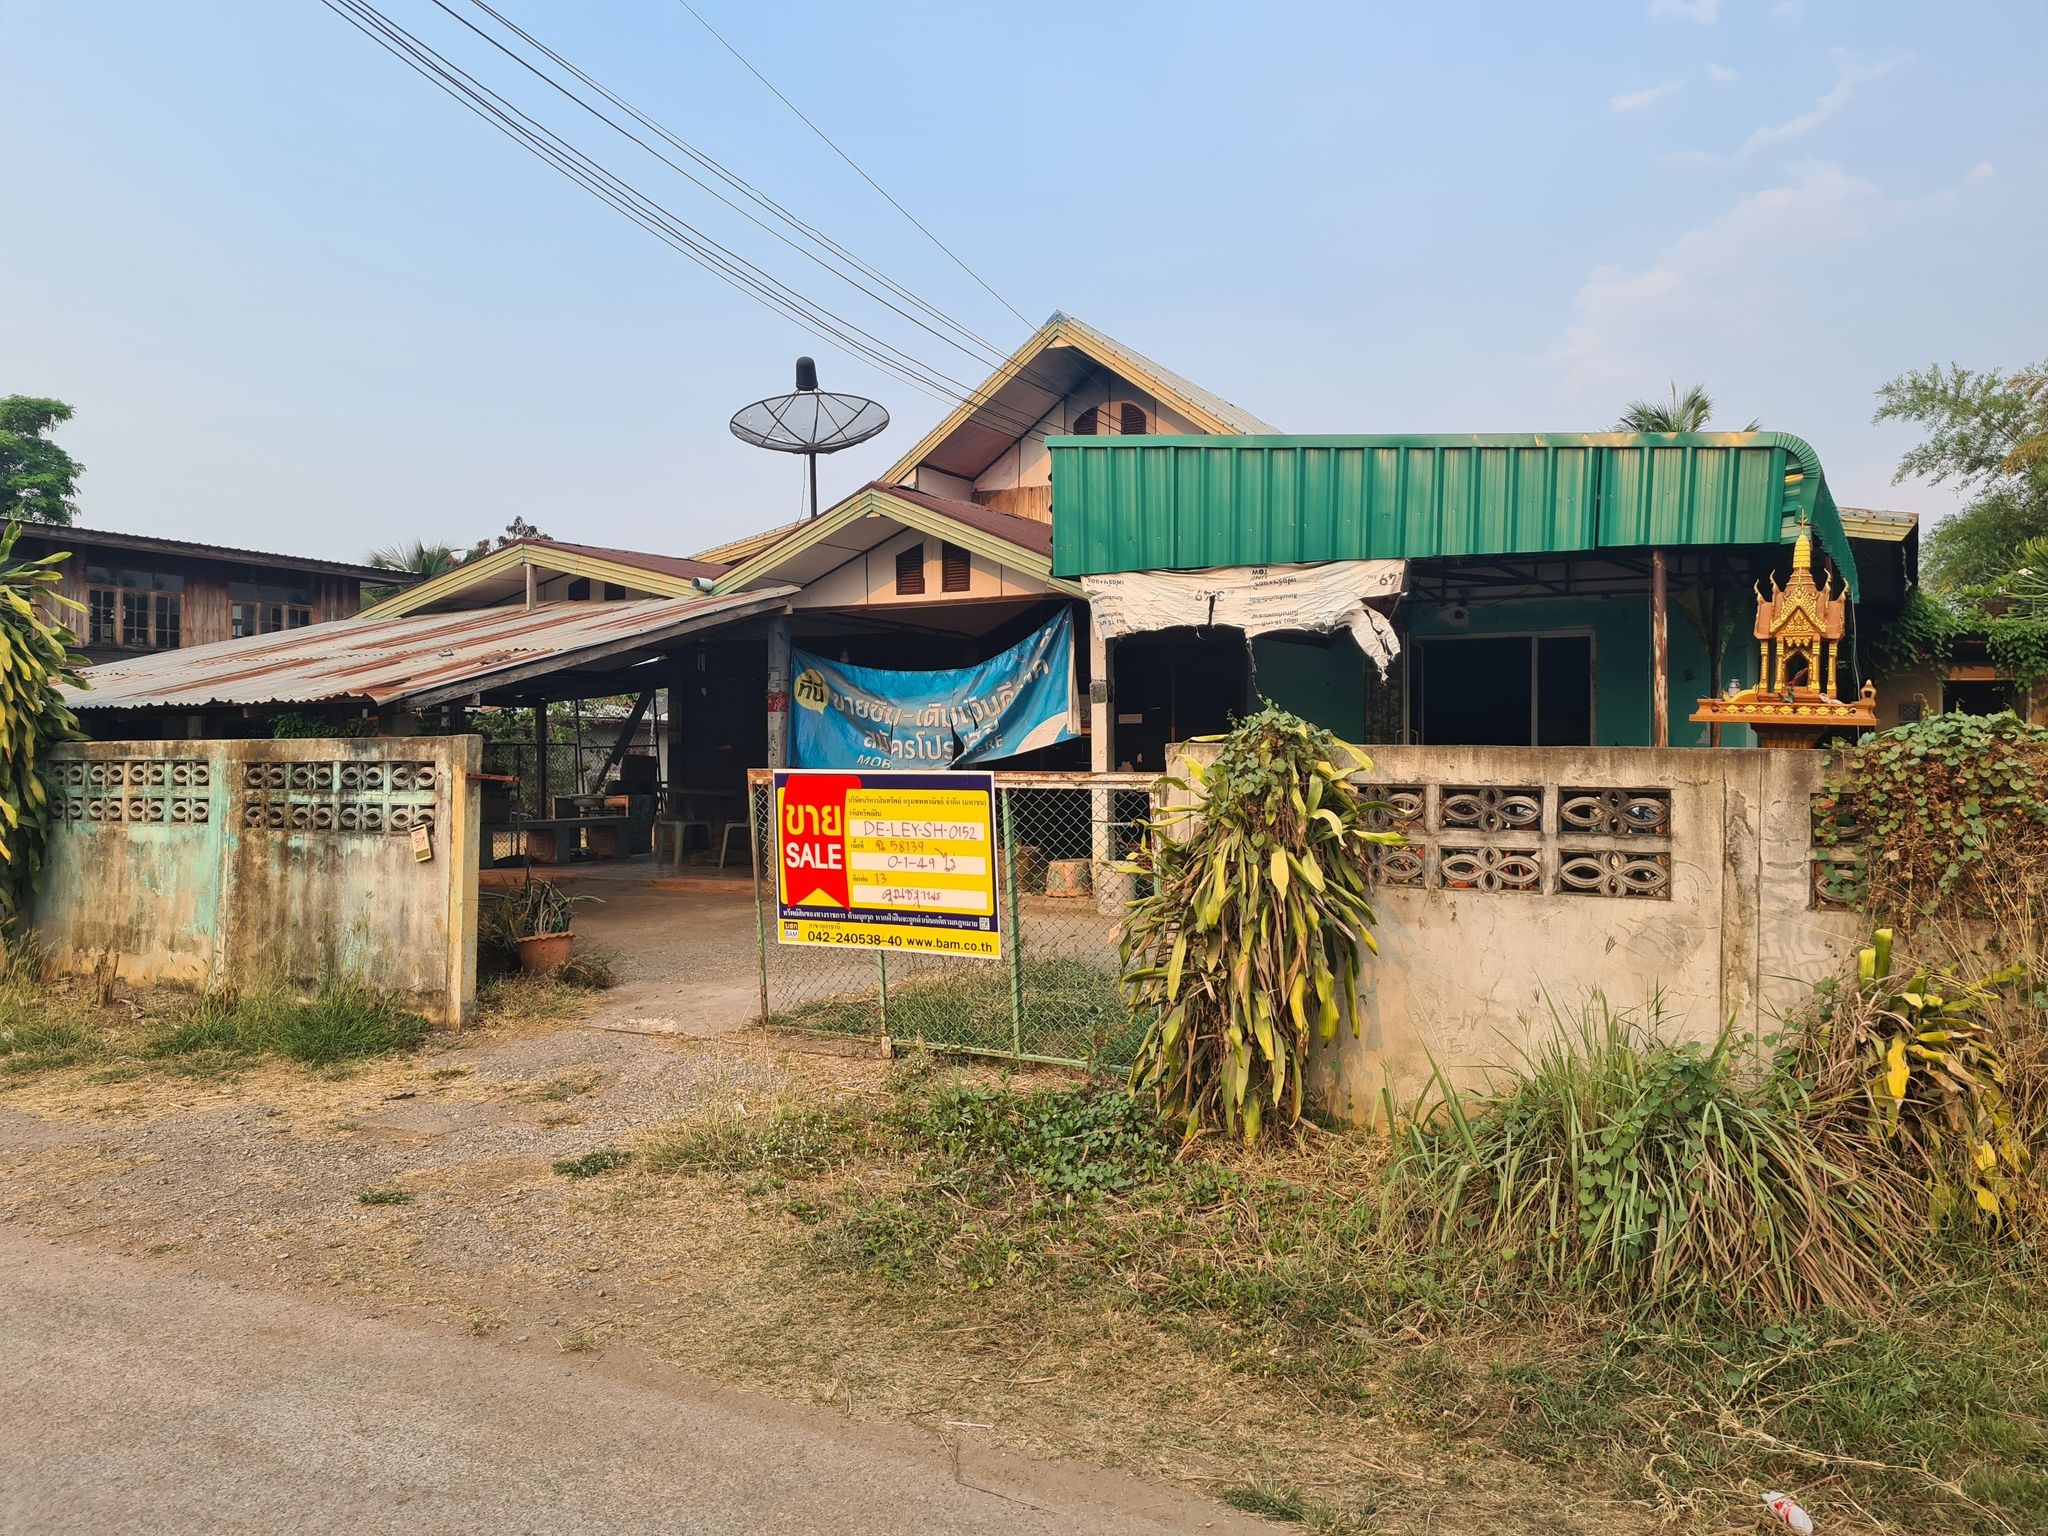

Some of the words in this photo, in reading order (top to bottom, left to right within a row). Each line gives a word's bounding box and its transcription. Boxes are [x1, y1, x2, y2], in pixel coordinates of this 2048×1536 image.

[797, 674, 825, 703] ที่นี่
[786, 804, 842, 837] ขาย
[863, 820, 977, 841] DE-LEY-SH-0152
[785, 842, 842, 870] SALE
[889, 840, 924, 853] 58139
[887, 855, 936, 869] 0-1-49
[807, 931, 902, 947] 042-240538-40
[906, 937, 993, 952] www.bam.co.th
